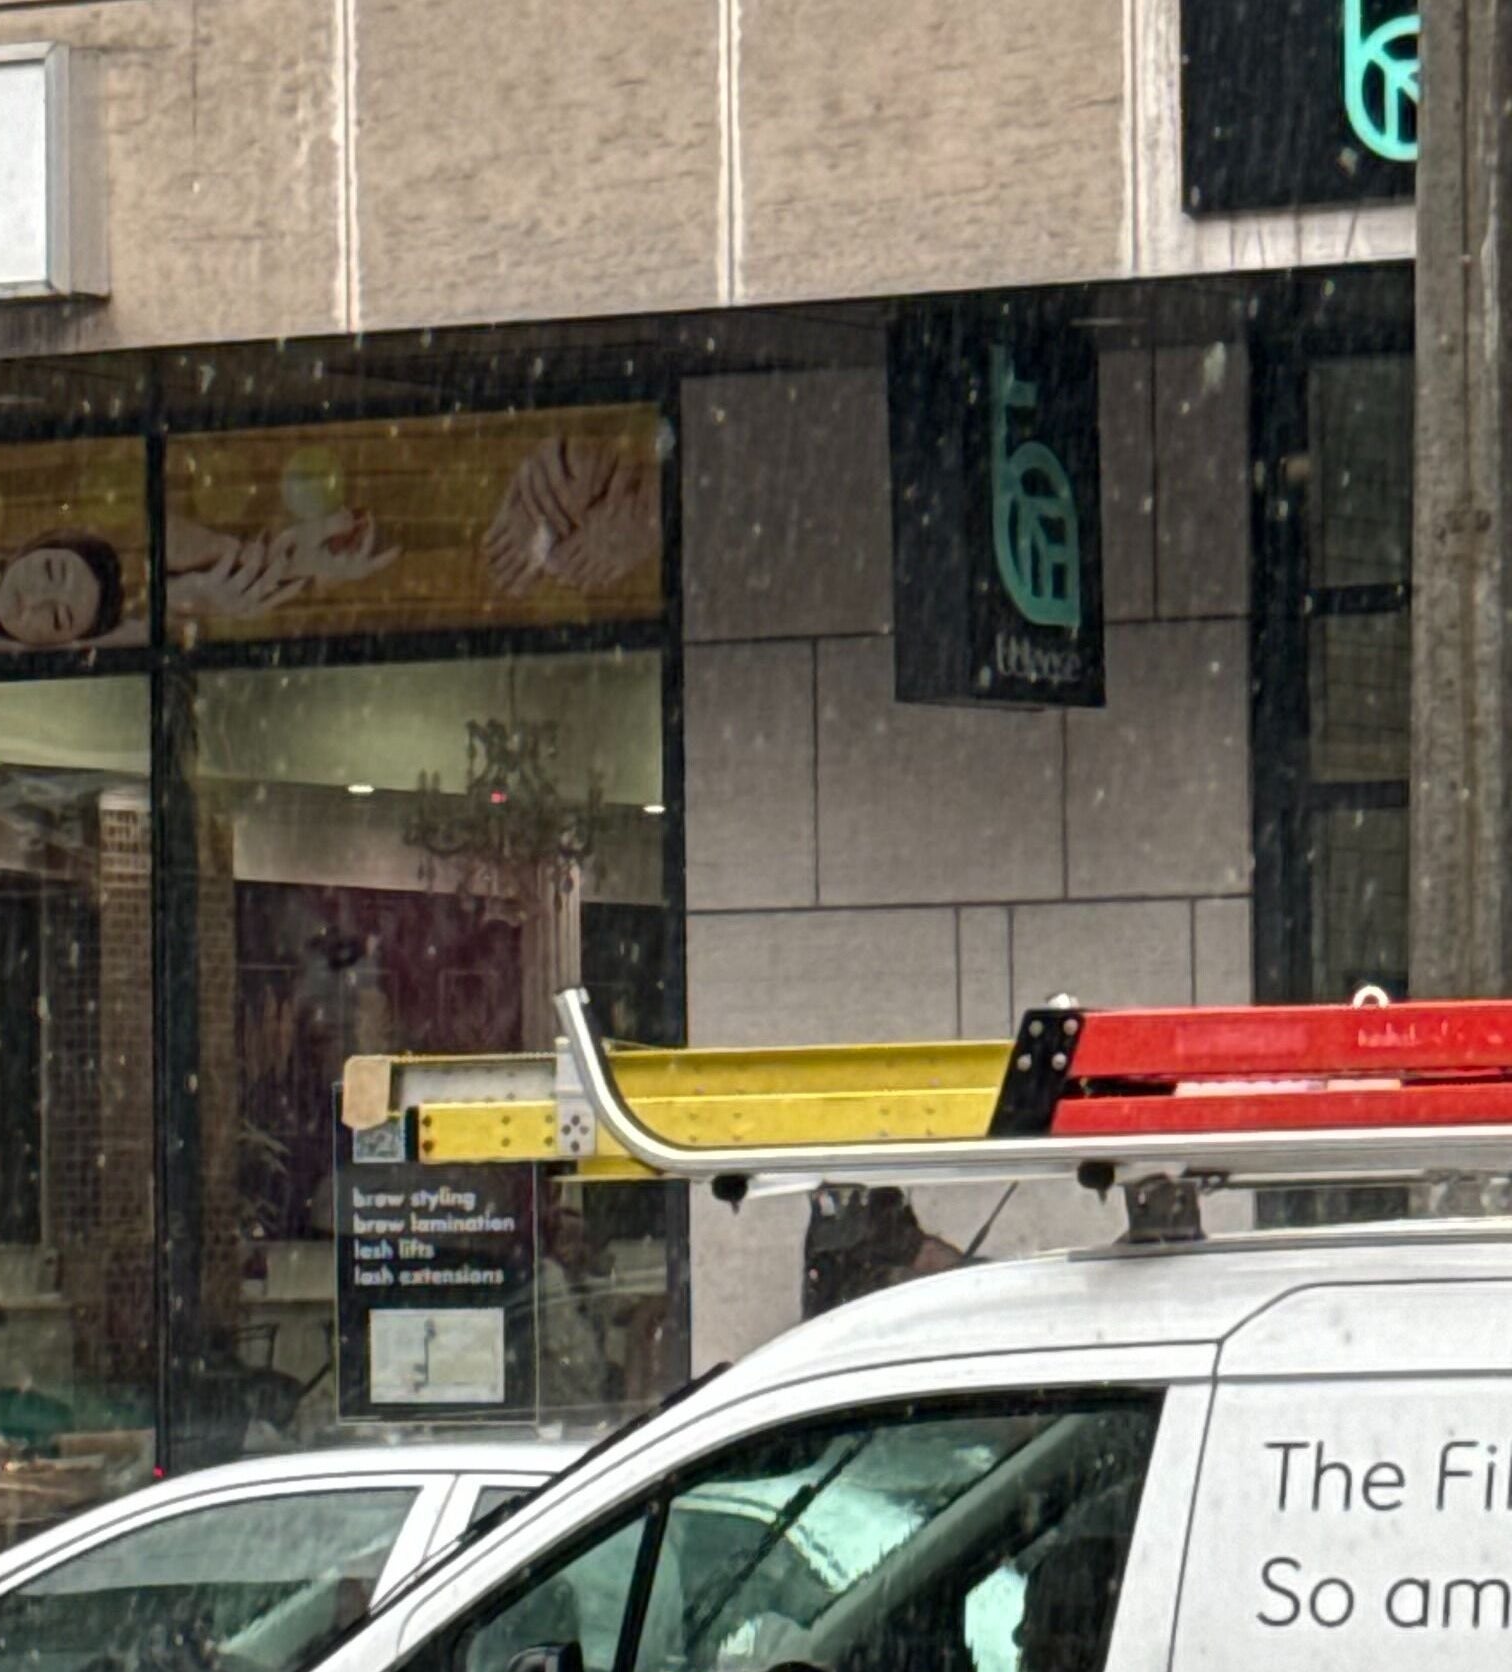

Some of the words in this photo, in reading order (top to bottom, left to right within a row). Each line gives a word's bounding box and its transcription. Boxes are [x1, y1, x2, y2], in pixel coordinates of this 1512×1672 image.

[352, 1186, 405, 1208] brow
[410, 1185, 477, 1212] styling
[353, 1212, 406, 1234] brow
[410, 1211, 515, 1233] lamination
[354, 1238, 393, 1260] lash
[399, 1238, 435, 1260] lifts
[354, 1264, 394, 1286] lash
[399, 1264, 505, 1286] extensions
[1264, 1440, 1406, 1512] The
[1256, 1556, 1355, 1629] So
[1385, 1576, 1511, 1629] am
